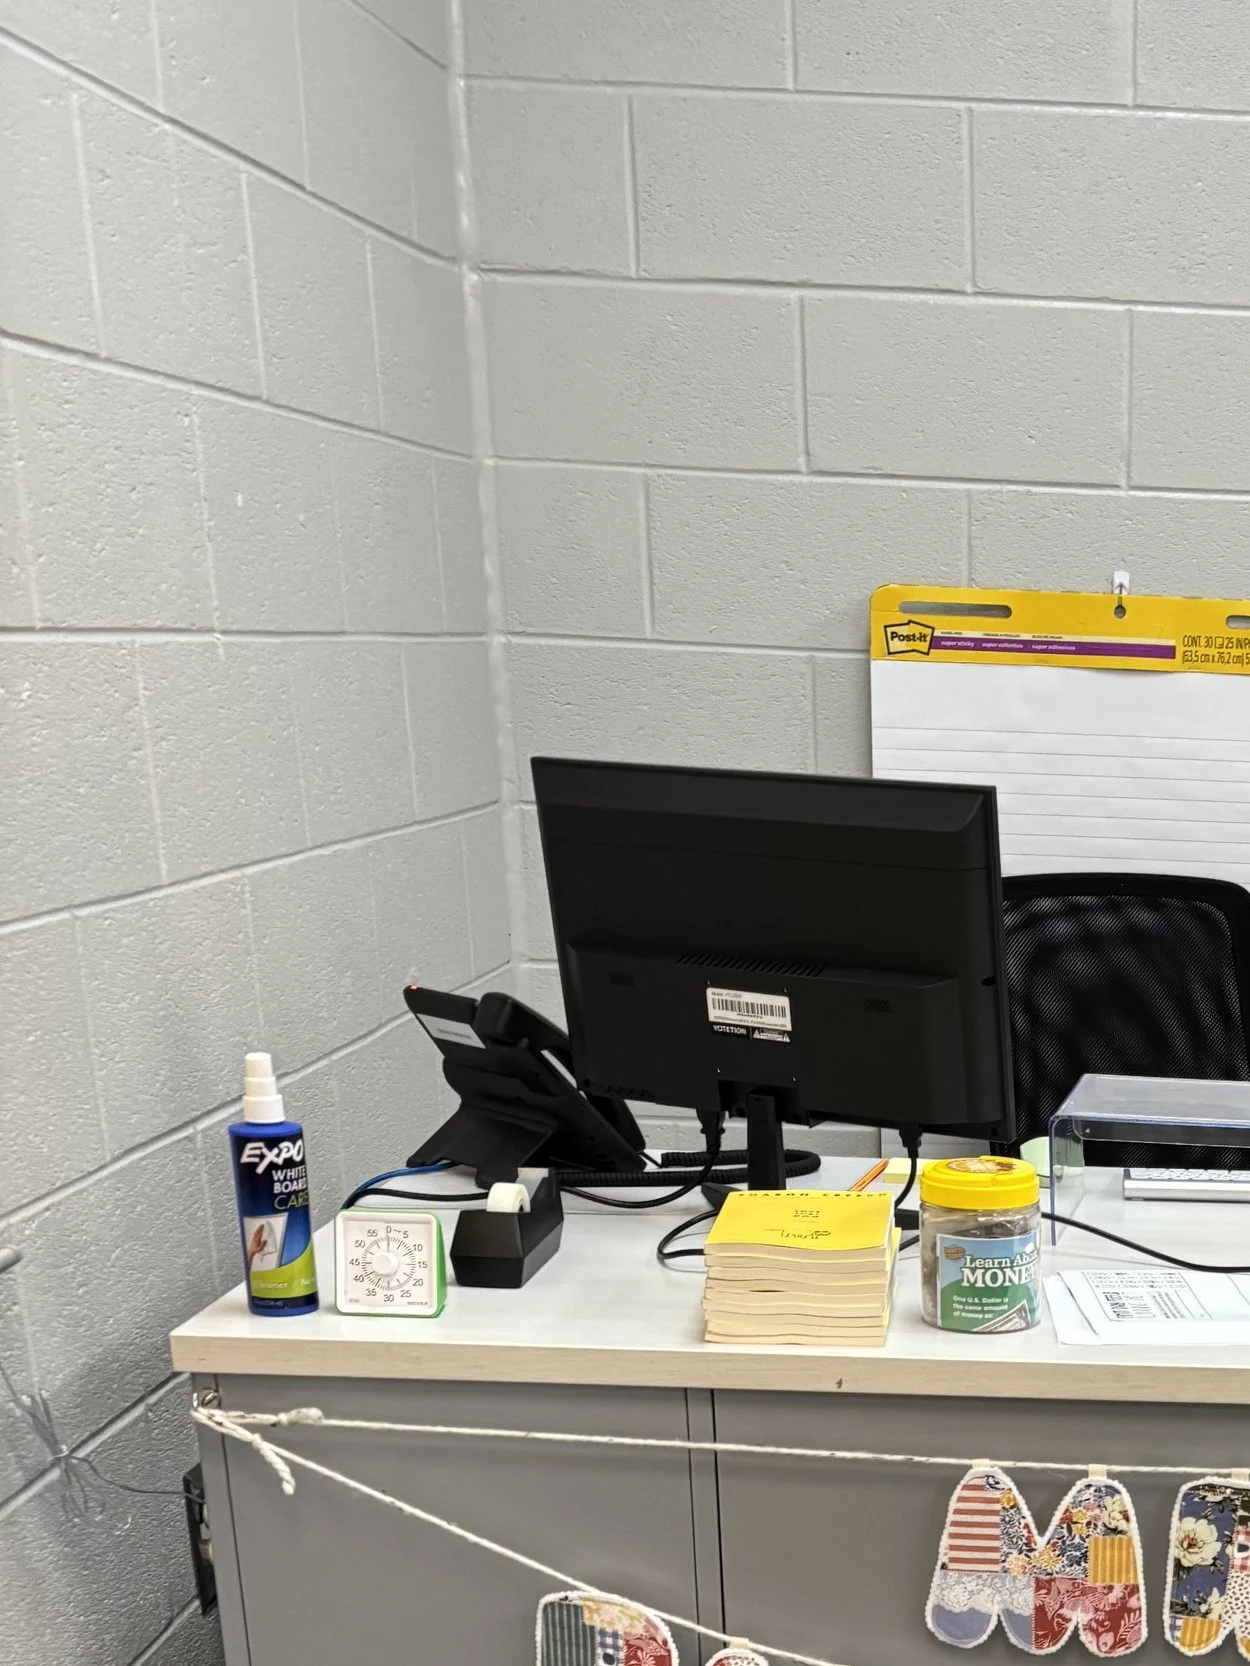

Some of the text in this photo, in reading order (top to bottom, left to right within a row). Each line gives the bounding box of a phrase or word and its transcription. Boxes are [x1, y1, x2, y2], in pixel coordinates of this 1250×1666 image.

[890, 631, 928, 643] Post-it
[1204, 636, 1213, 648] 30
[1225, 637, 1234, 649] 25
[240, 1139, 304, 1174] EXPO
[271, 1165, 306, 1181] WHITE
[367, 1229, 378, 1237] 55
[386, 1226, 392, 1234] 0
[355, 1240, 365, 1248] 50
[349, 1258, 360, 1266] 45
[965, 1255, 1011, 1268] Learn
[413, 1279, 423, 1287] 20
[366, 1288, 377, 1296] 35
[400, 1290, 411, 1298] 25
[383, 1294, 394, 1302] 30
